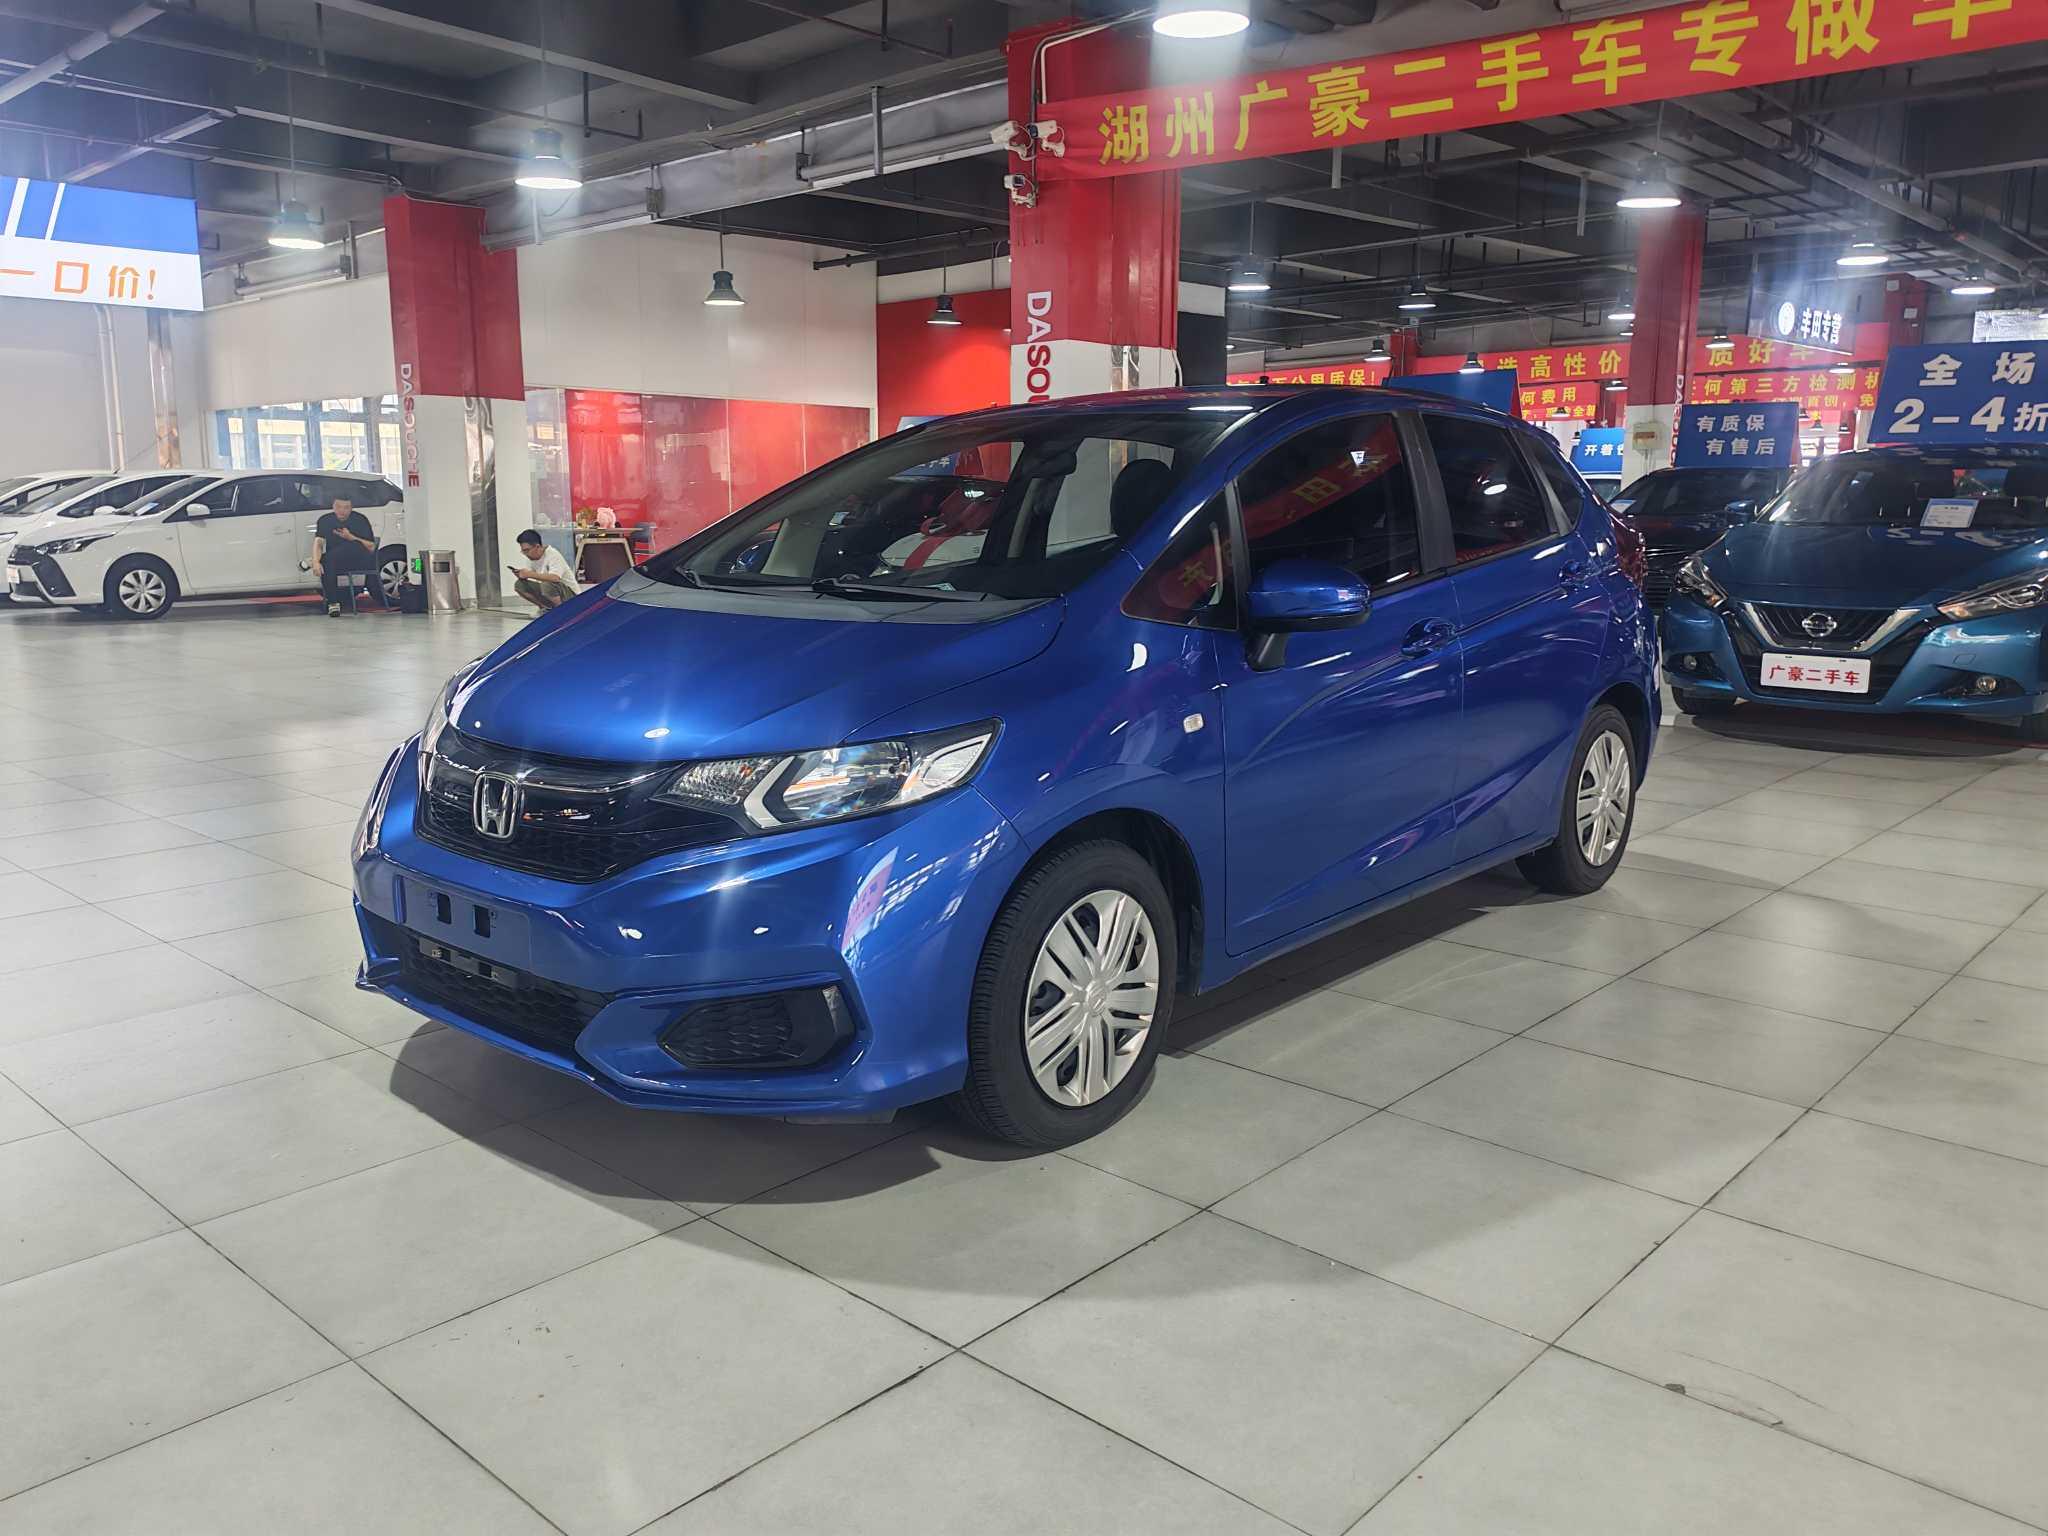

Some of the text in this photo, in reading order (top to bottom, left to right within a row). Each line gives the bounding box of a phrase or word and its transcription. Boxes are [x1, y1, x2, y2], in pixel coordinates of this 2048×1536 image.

[0, 261, 156, 300] 一口价!
[1919, 353, 2036, 386] 全场
[400, 363, 420, 487] DASOUCHE
[1697, 414, 1765, 433] 有质保
[1706, 437, 1776, 456] 有售后
[1769, 664, 1861, 687] 广豪二手车
